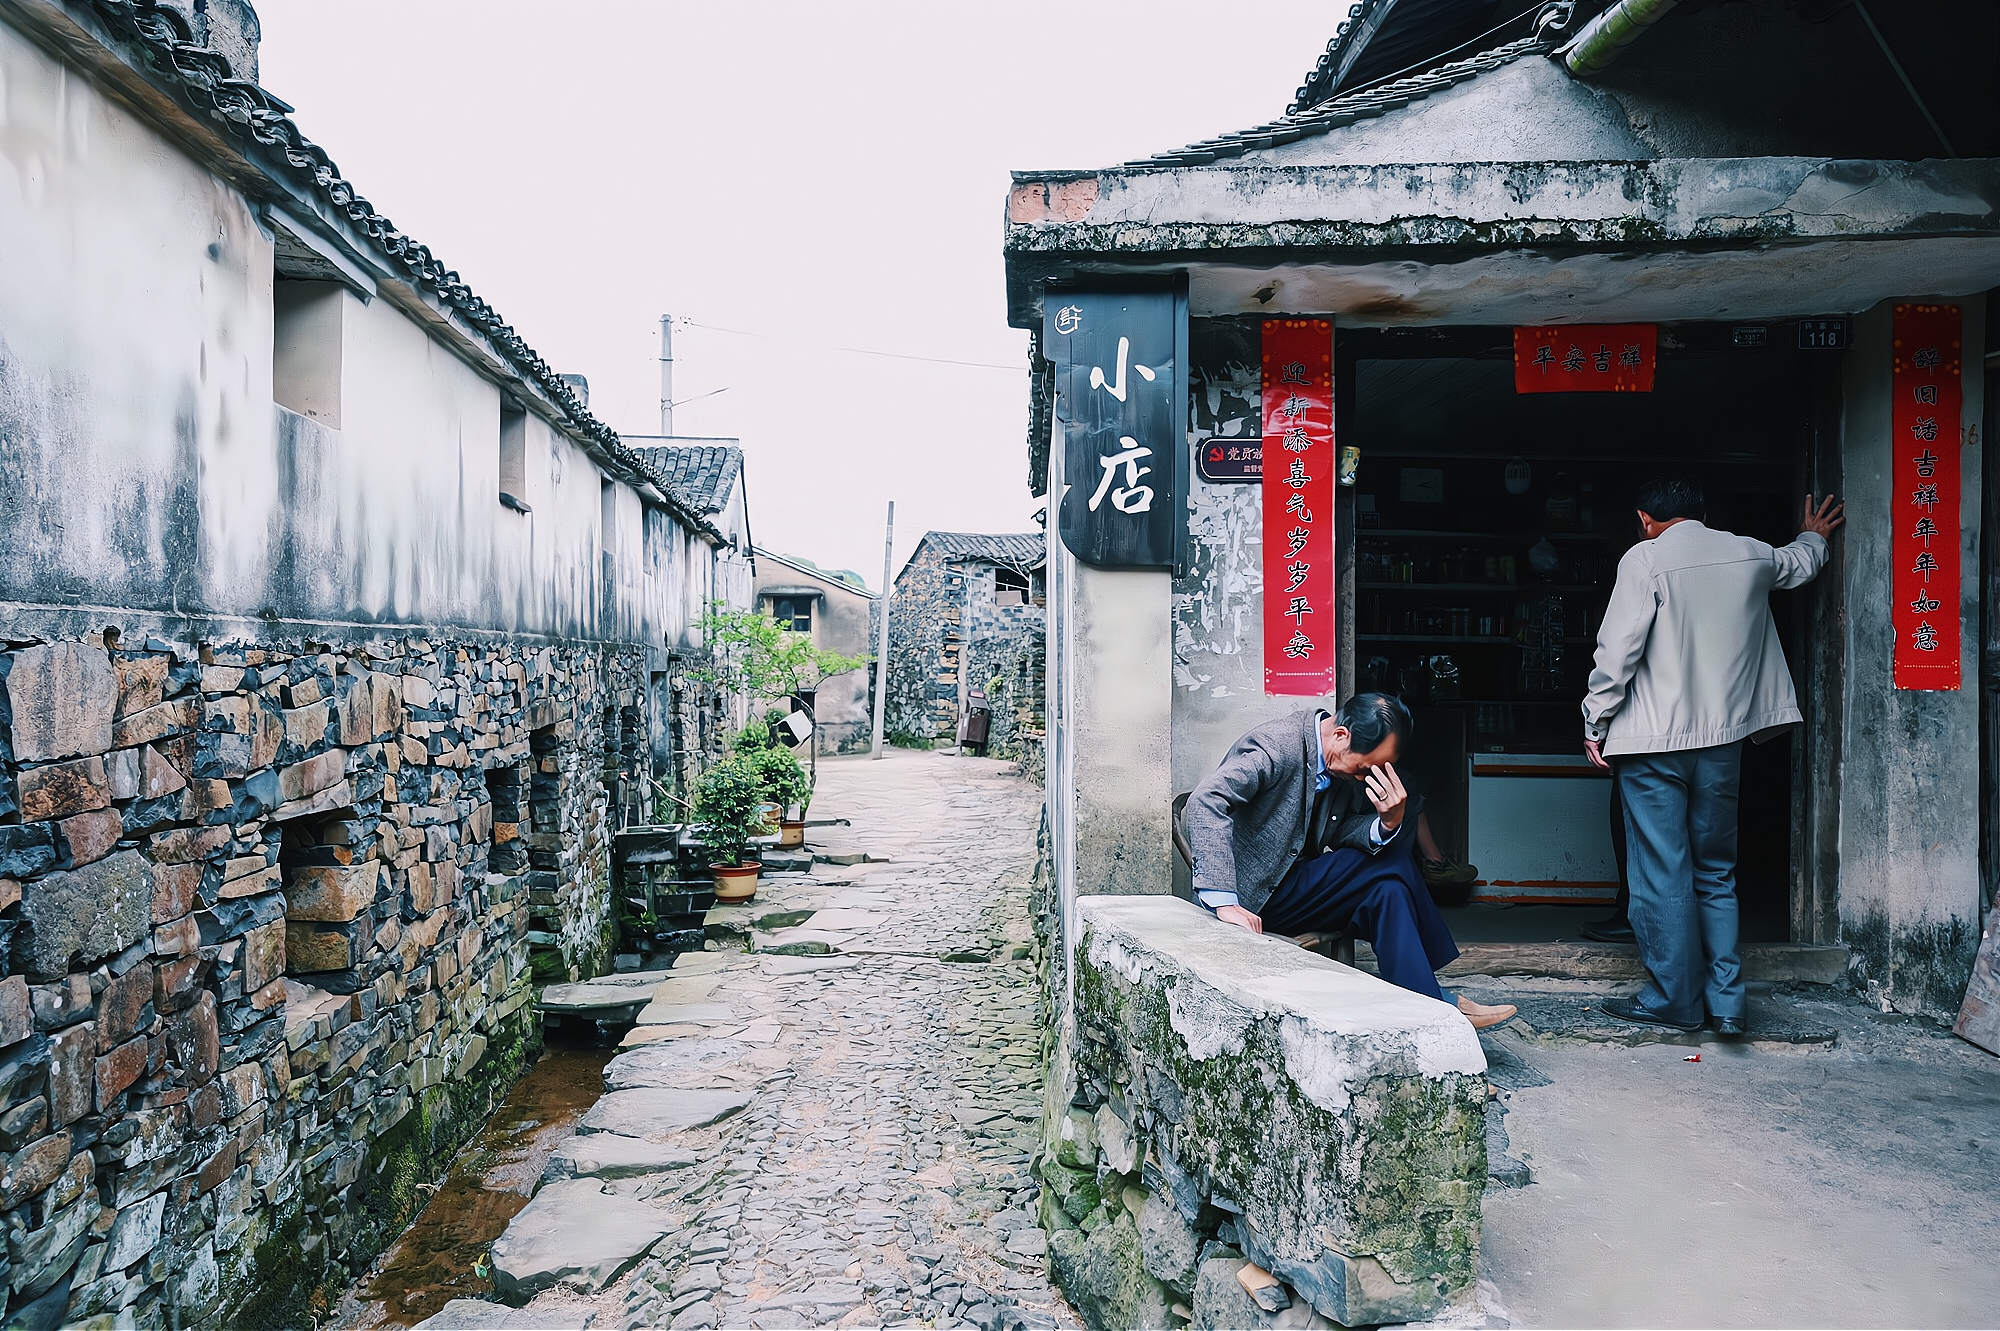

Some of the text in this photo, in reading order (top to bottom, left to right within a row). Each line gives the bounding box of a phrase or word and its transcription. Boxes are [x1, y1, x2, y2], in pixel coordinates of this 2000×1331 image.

[1089, 336, 1155, 514] 小店
[1532, 344, 1642, 375] 平安吉祥
[1809, 332, 1836, 346] 118
[1280, 361, 1314, 660] 迎新添喜气岁岁平安
[1911, 344, 1941, 652] 辞旧话吉祥年年如意
